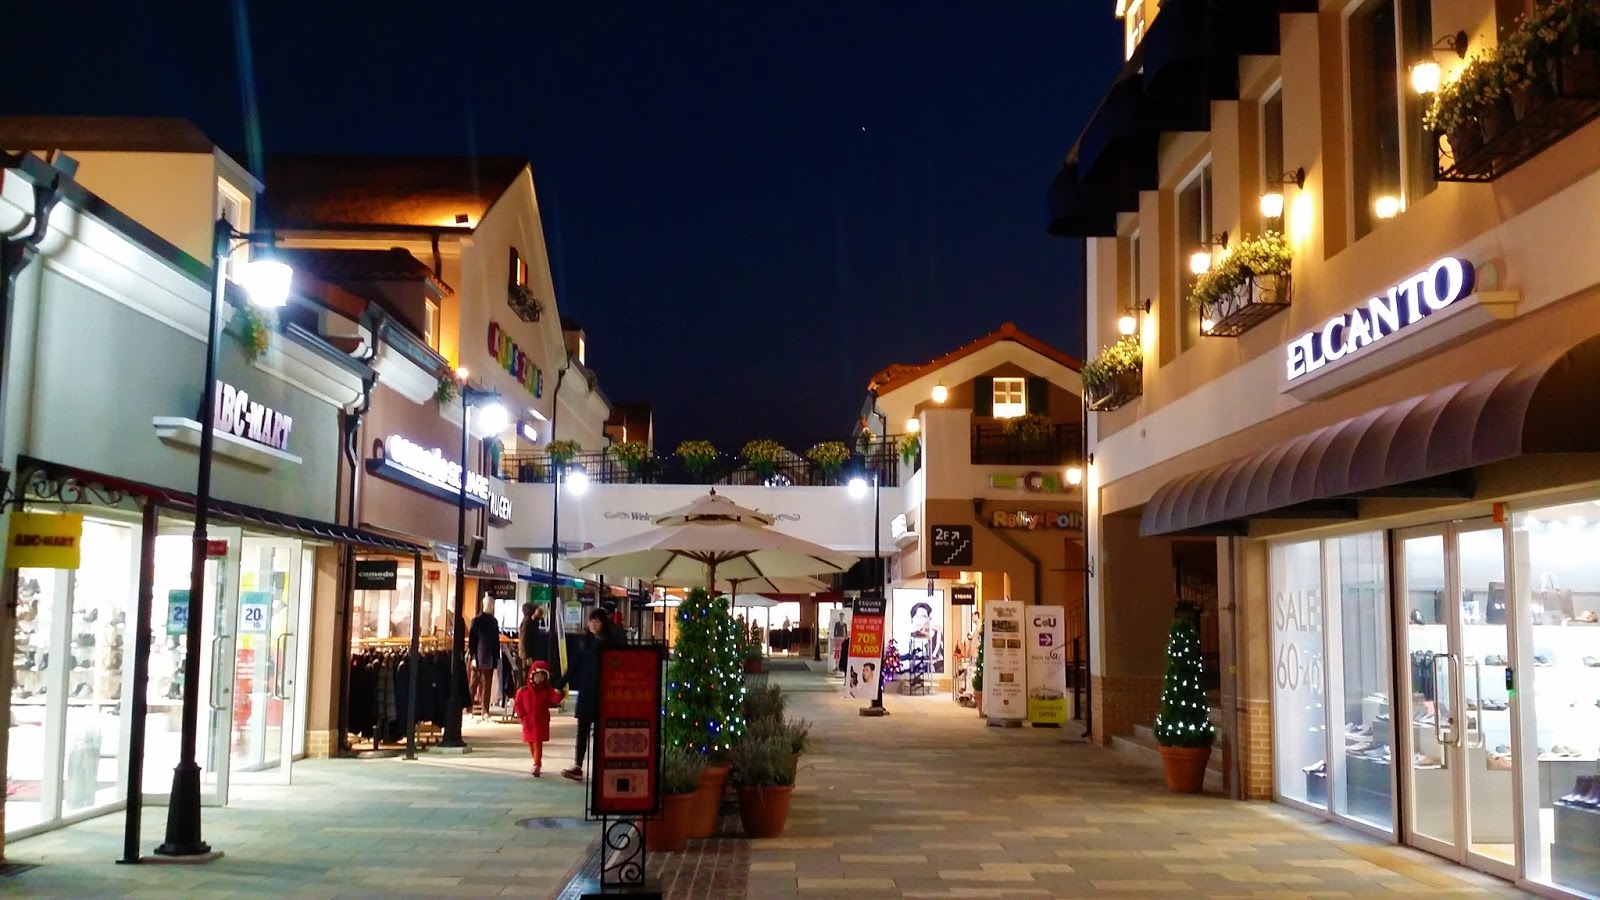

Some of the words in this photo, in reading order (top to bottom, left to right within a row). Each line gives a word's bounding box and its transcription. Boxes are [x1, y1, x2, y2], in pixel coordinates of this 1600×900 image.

[1287, 257, 1473, 381] ELCANTO
[993, 510, 1039, 529] Rolly
[935, 528, 949, 540] 2F
[358, 570, 394, 578] comodo
[1276, 590, 1320, 632] SALE
[852, 644, 879, 654] 79,000
